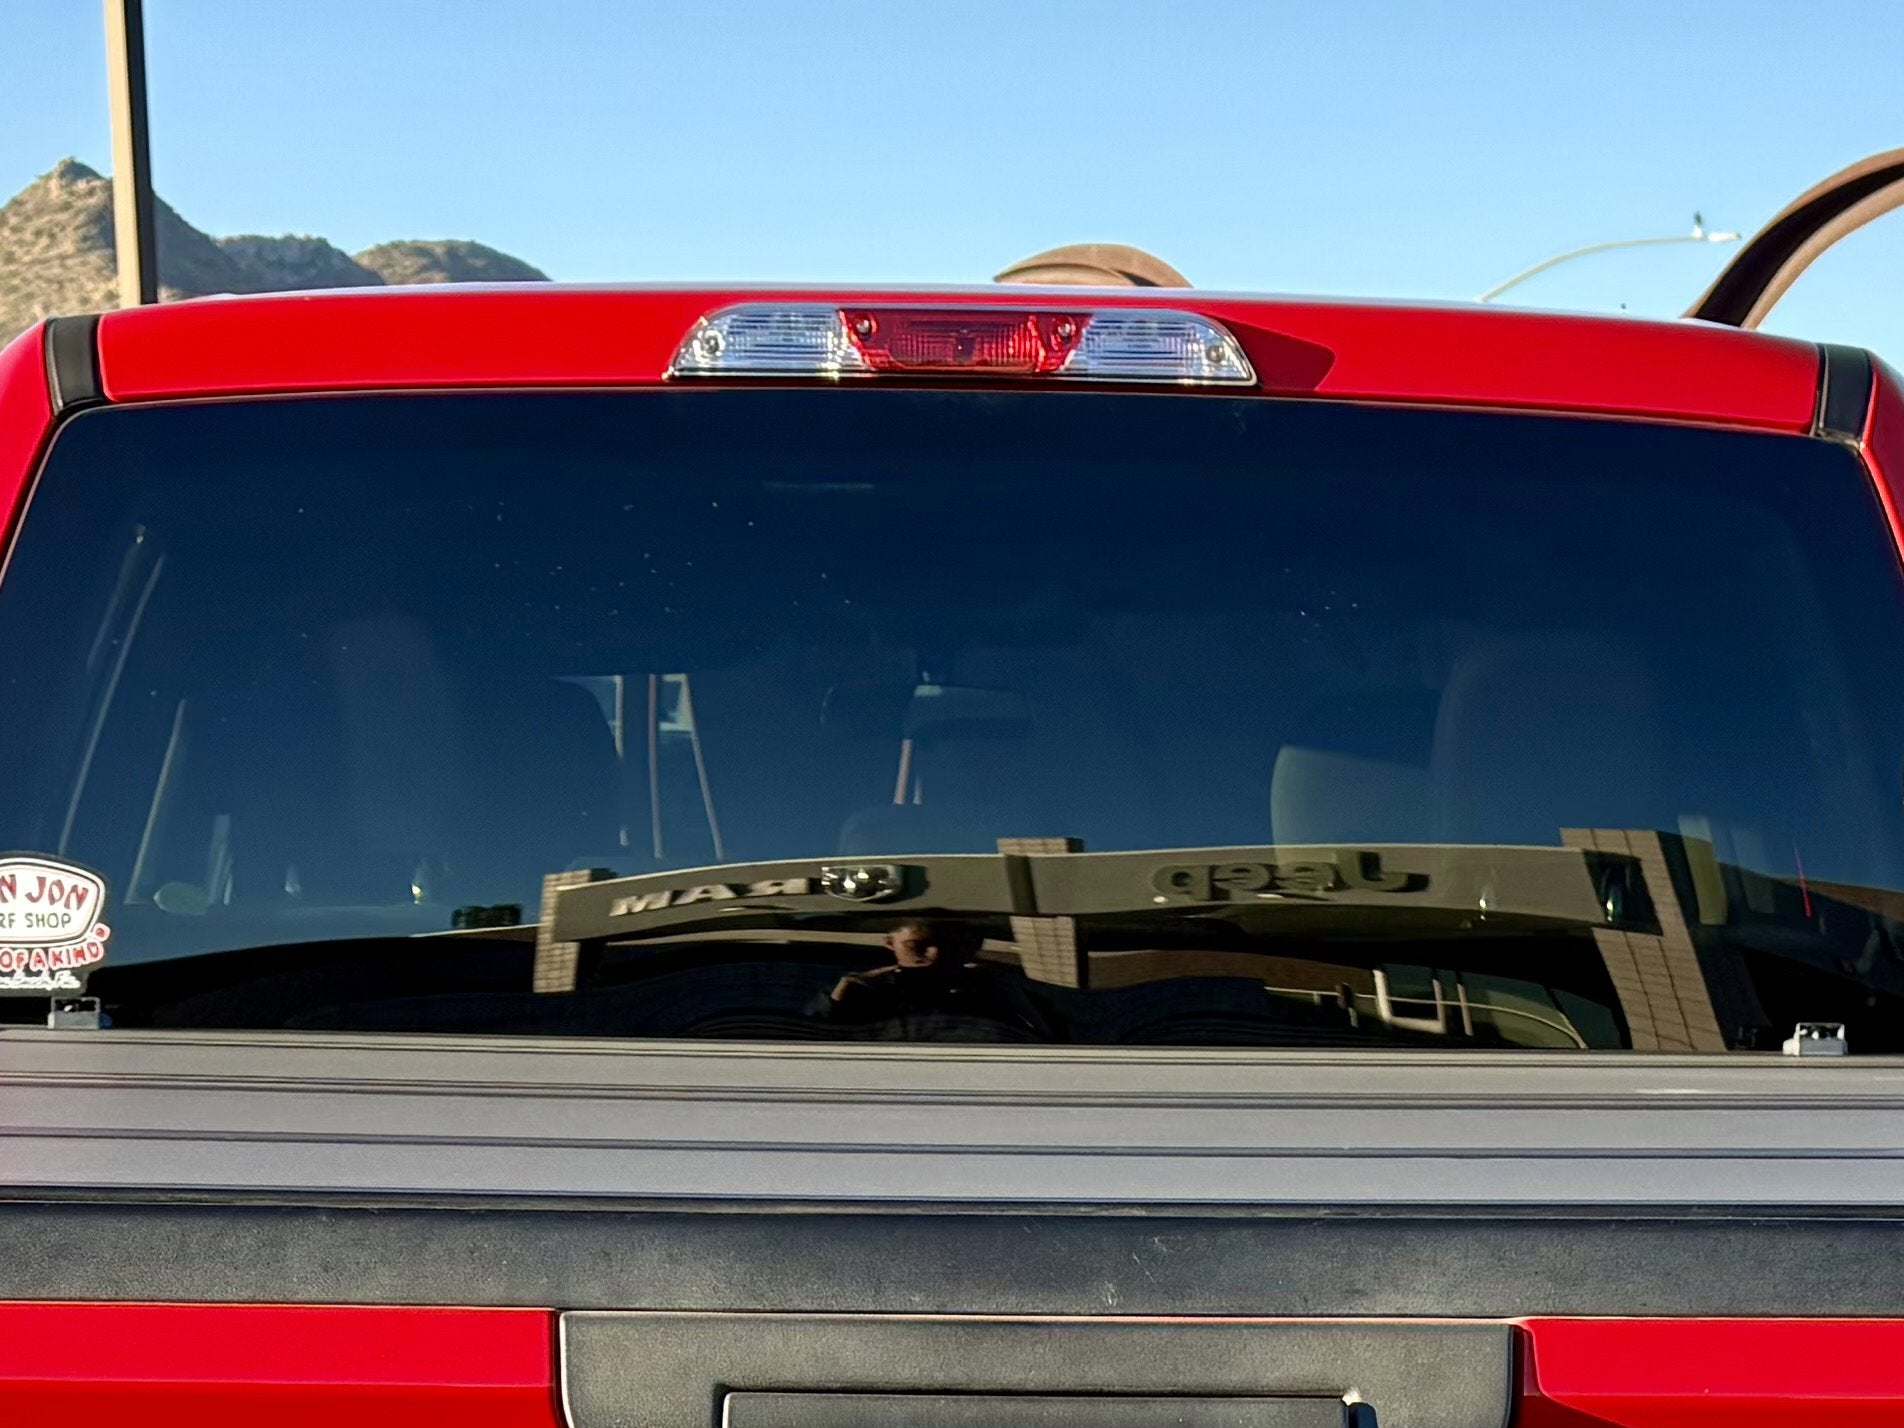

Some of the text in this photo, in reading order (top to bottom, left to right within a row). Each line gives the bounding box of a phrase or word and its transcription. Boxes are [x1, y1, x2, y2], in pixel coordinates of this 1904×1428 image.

[26, 875, 90, 912] JON
[25, 912, 72, 929] SHOP
[31, 948, 48, 969] A
